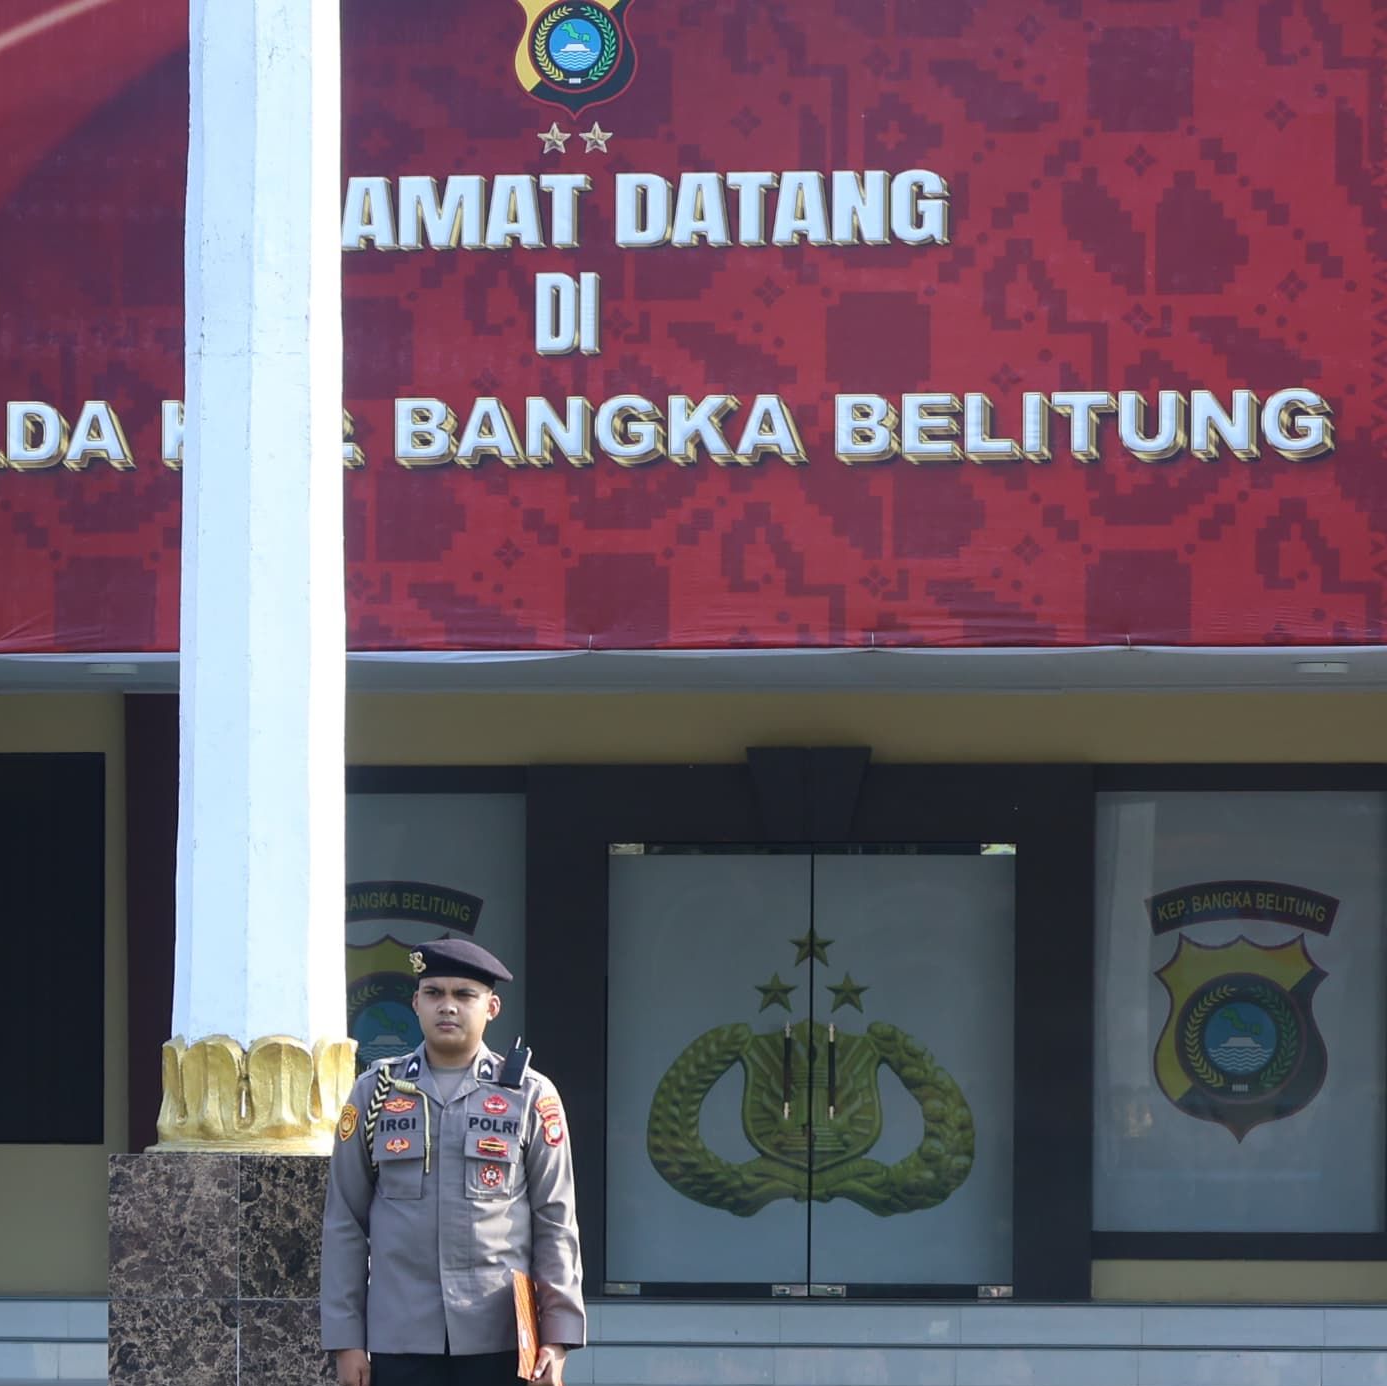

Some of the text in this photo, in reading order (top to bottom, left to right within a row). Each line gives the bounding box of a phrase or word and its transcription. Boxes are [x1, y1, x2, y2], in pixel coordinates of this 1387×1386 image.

[341, 169, 951, 250] AMAT DATANG
[534, 271, 601, 356] DI
[393, 394, 809, 468] BANGKA
[834, 388, 1337, 467] BELITUNG
[345, 891, 471, 922] ANGKA BELITUNG
[1157, 891, 1326, 923] KEP. BANGKA BELITUNG
[380, 1117, 417, 1133] IRGI
[468, 1116, 518, 1135] POLRI
